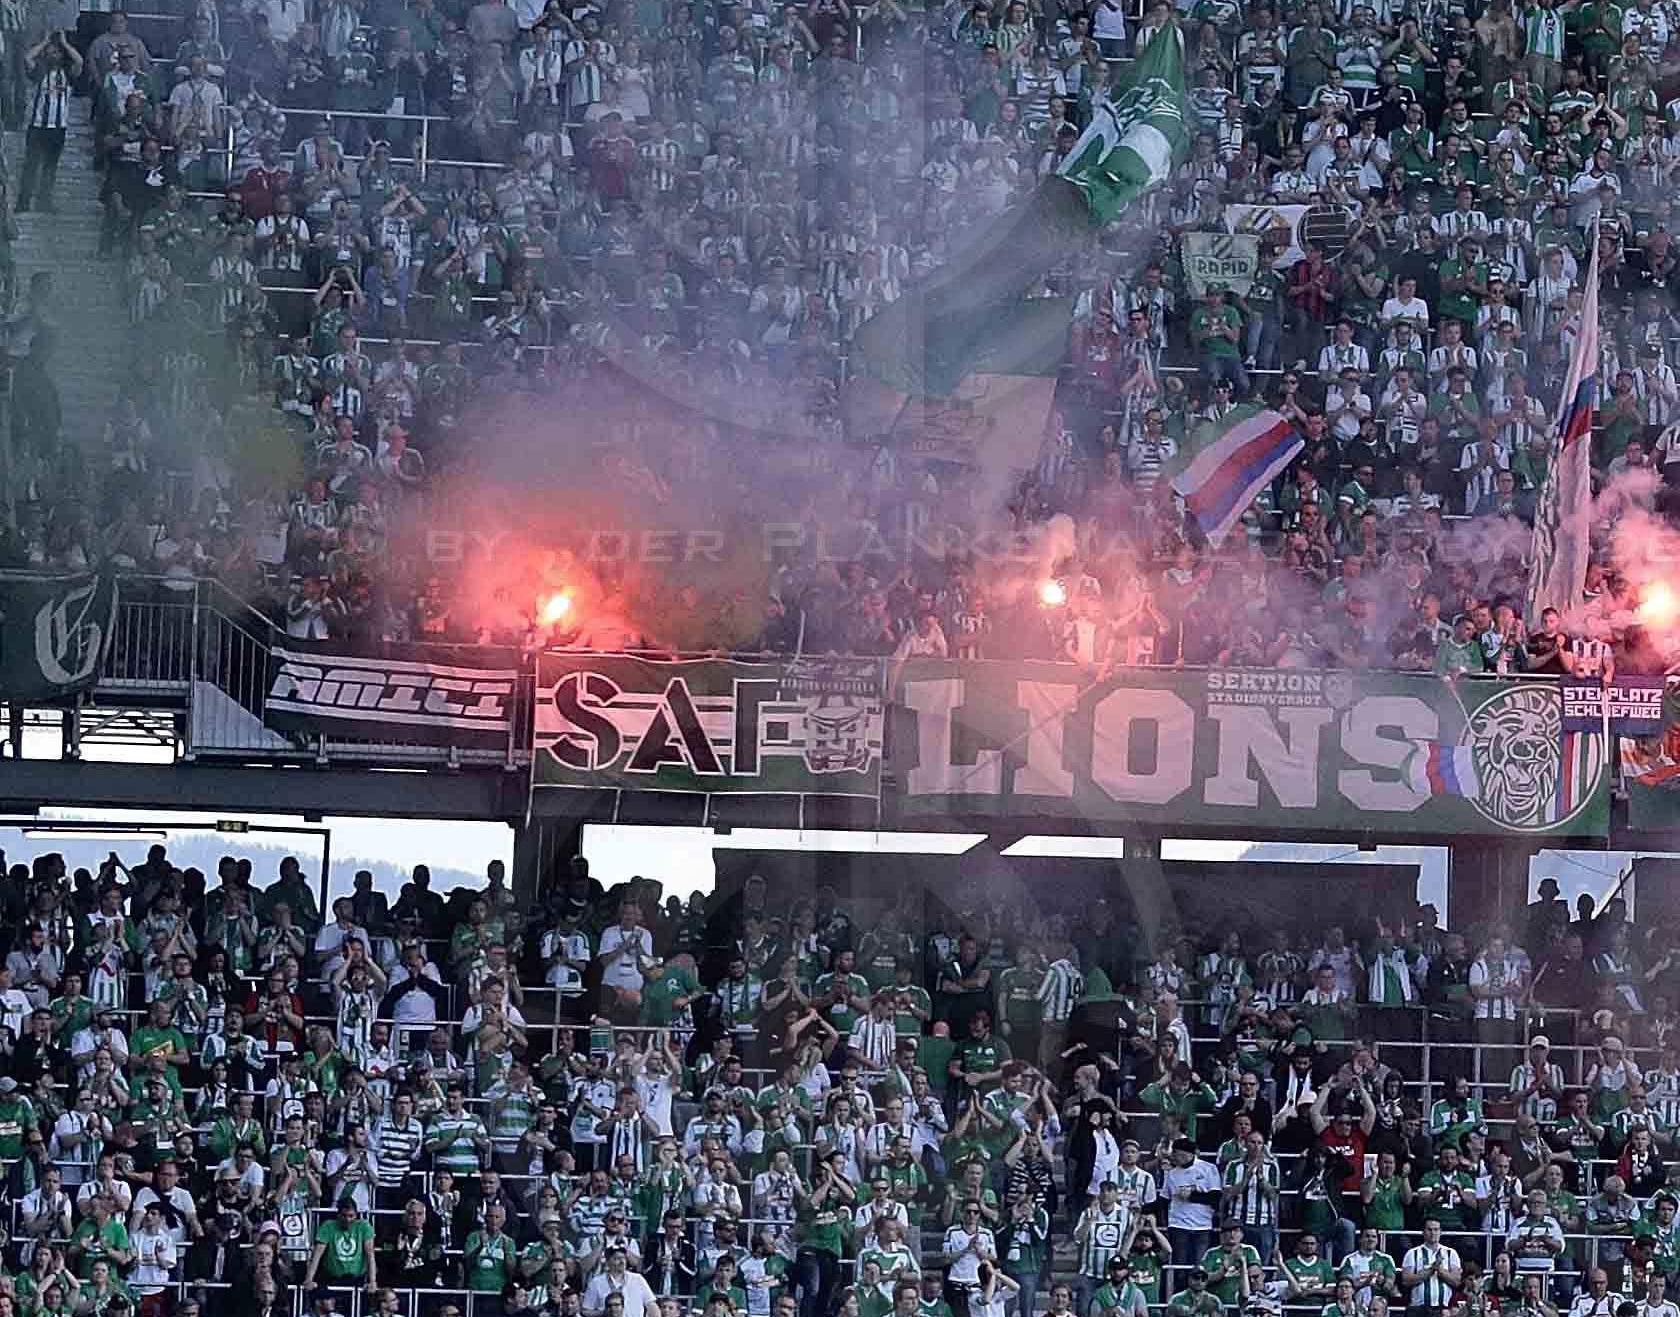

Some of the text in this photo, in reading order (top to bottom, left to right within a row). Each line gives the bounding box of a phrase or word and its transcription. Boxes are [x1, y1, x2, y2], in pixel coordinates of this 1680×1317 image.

[1197, 258, 1249, 276] RAPID
[1207, 673, 1322, 691] SEKTION
[1563, 686, 1664, 702] STEHPLATZ
[903, 676, 1440, 814] LIONS
